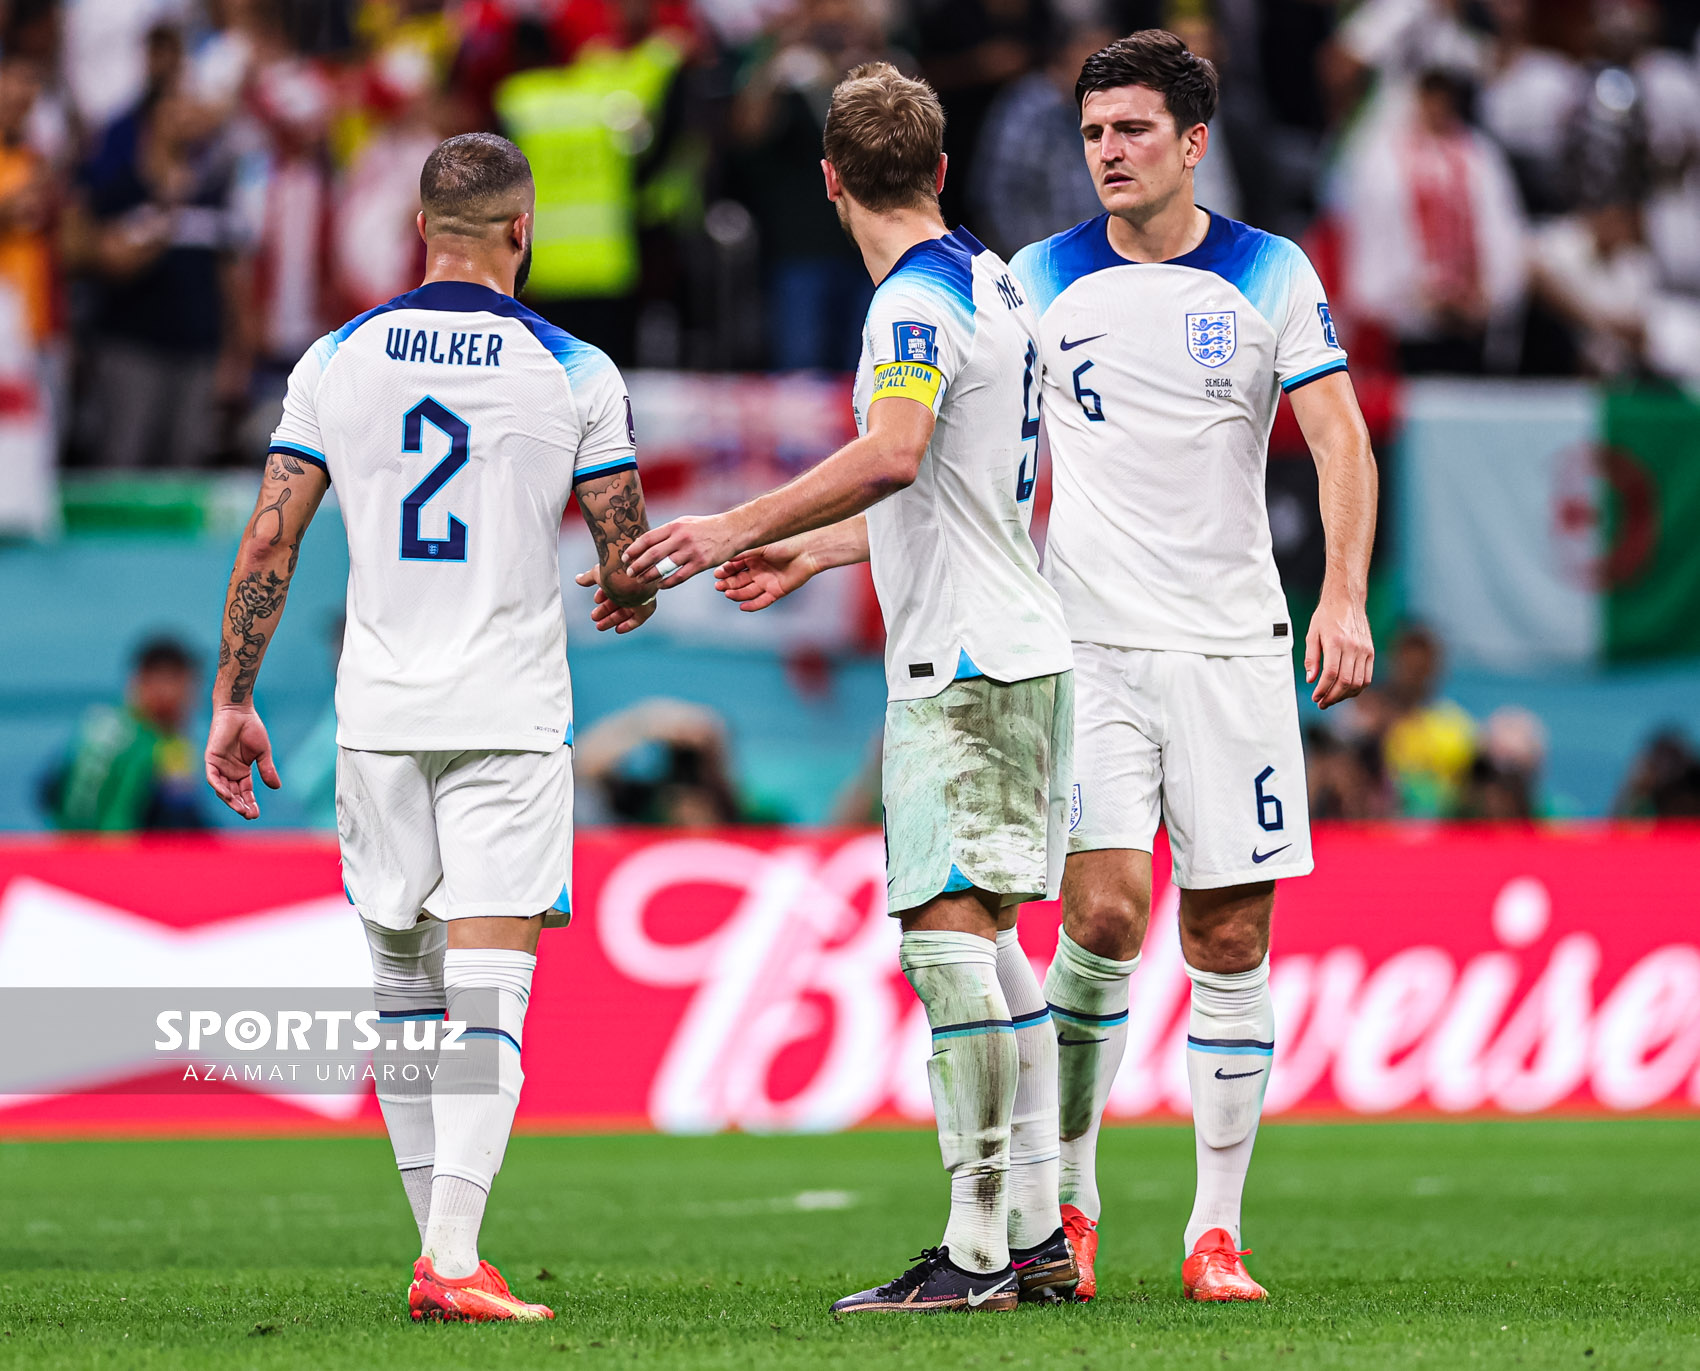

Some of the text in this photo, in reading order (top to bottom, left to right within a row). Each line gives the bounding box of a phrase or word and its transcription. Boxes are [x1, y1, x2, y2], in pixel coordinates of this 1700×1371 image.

[991, 274, 1024, 310] NE
[386, 327, 503, 366] WALKER
[886, 376, 906, 387] ALL
[1072, 359, 1106, 422] 6
[1205, 378, 1232, 387] SENEGAL
[1205, 389, 1232, 398] 04.12.22
[399, 394, 472, 562] 2
[1254, 765, 1284, 832] 6
